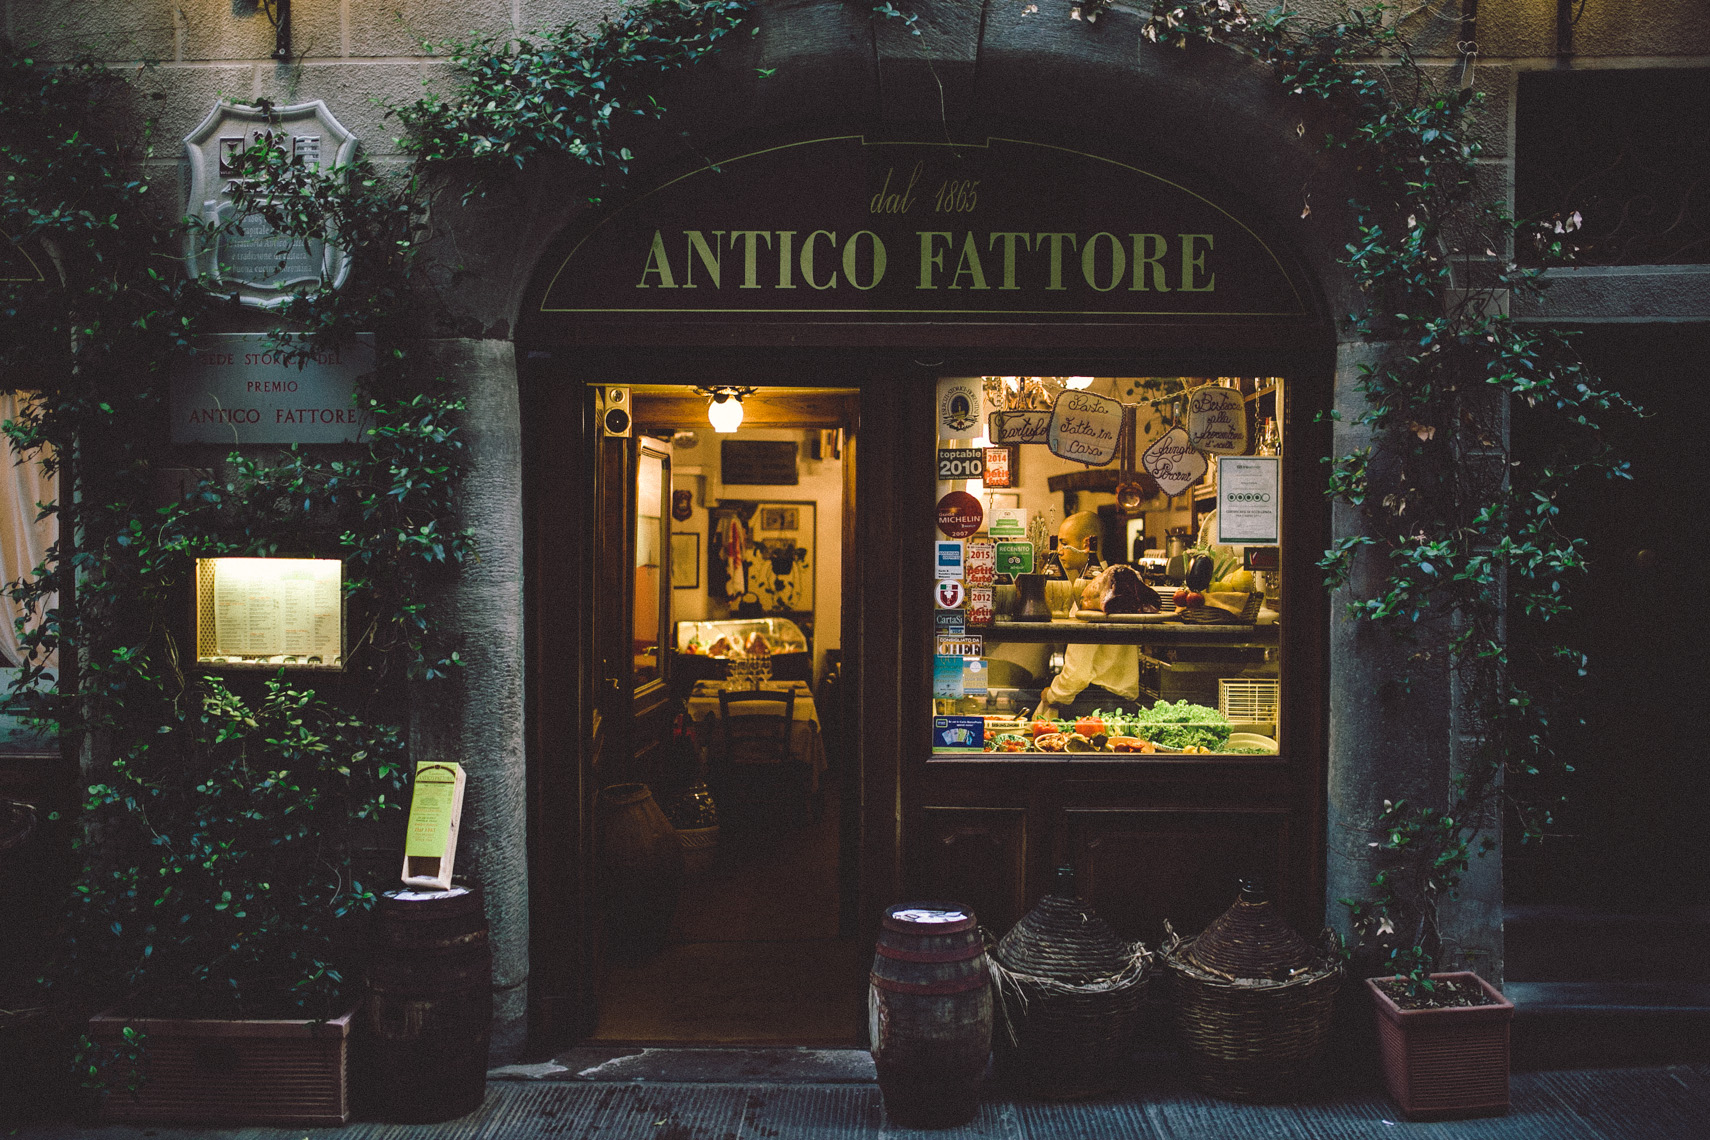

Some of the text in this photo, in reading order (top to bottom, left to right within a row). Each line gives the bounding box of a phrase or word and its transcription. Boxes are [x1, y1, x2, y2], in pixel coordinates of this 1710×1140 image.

[870, 160, 981, 215] dal 1865
[636, 229, 1217, 293] ANTICO FATTORE
[245, 353, 308, 367] STORIC
[317, 353, 343, 366] DEL
[247, 381, 299, 393] PREMIO
[1068, 394, 1109, 415] Pasta
[188, 409, 357, 424] ANTICO FATTORE
[1060, 417, 1113, 440] Fatta in
[1066, 440, 1104, 456] Casa
[940, 450, 982, 460] toptable
[988, 454, 1007, 463] 2014
[940, 460, 982, 475] 2010
[1151, 457, 1192, 482] Porcini
[984, 469, 1010, 480] petit
[938, 515, 982, 524] MICHELIN
[971, 550, 991, 559] 2015
[967, 566, 993, 577] petit
[972, 593, 991, 602] 2012
[939, 643, 981, 655] CHEF
